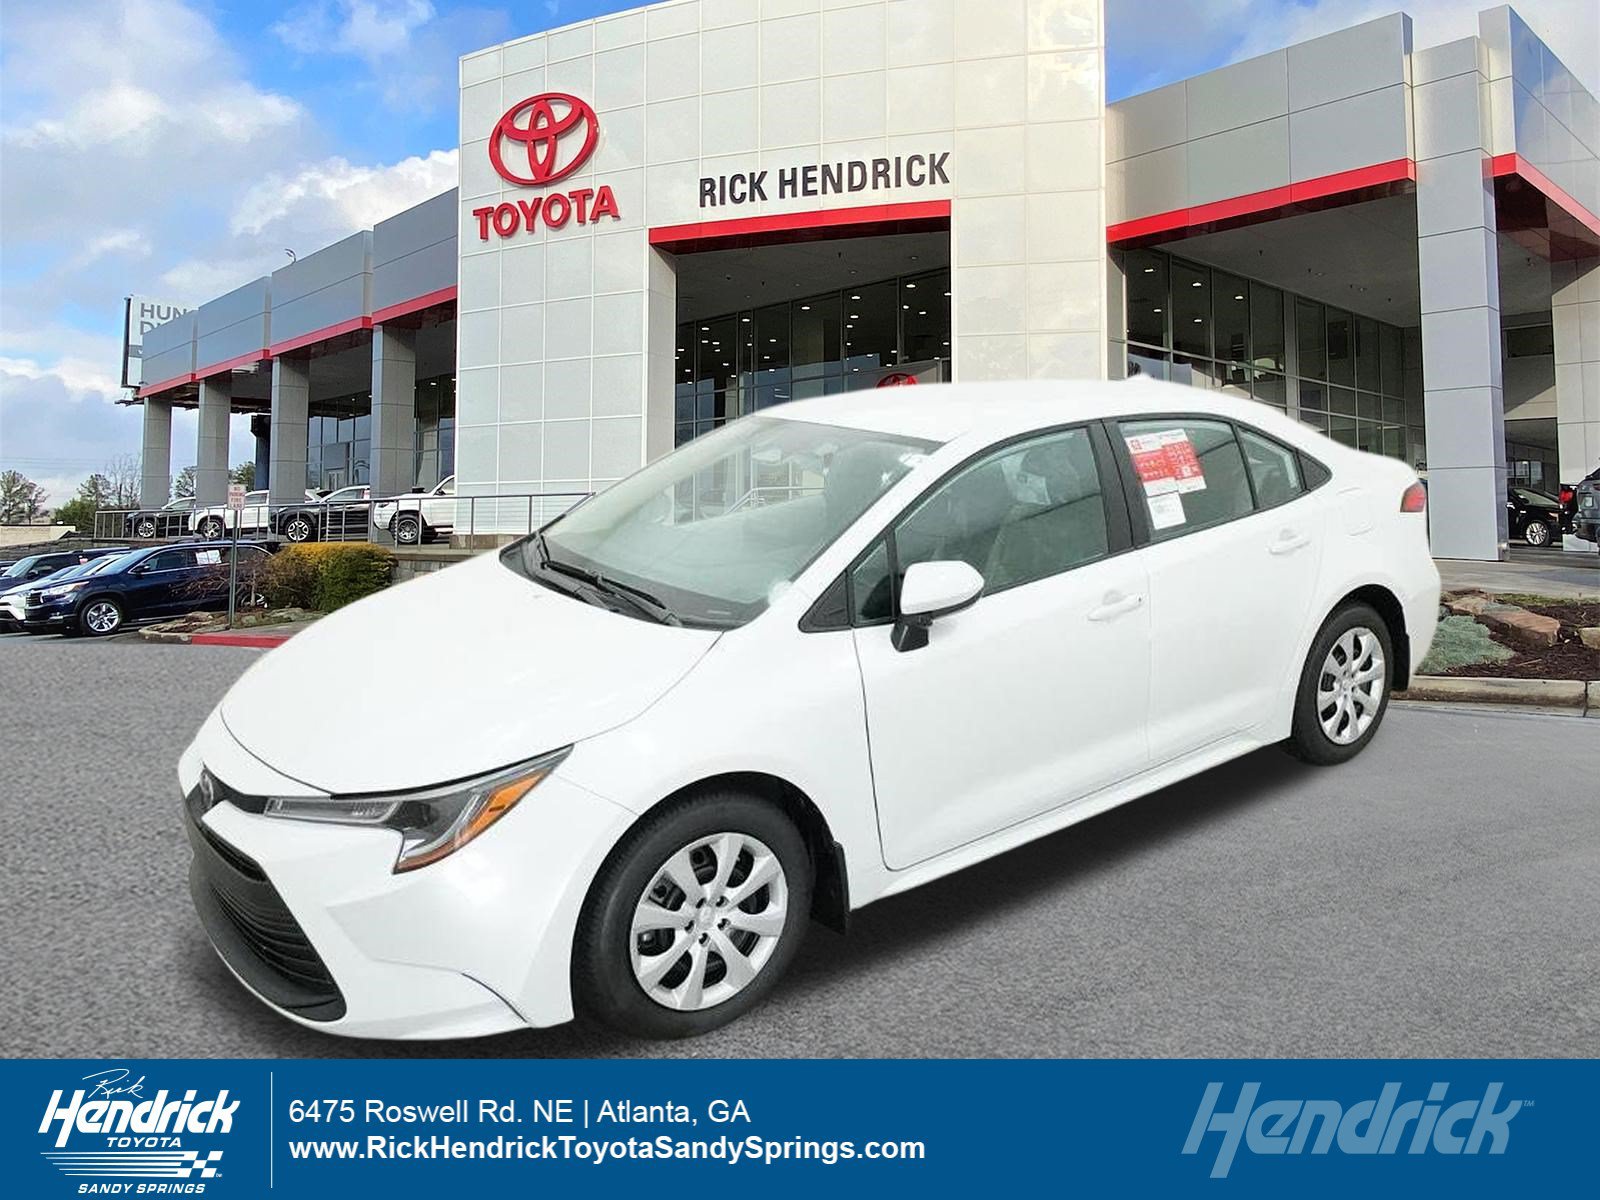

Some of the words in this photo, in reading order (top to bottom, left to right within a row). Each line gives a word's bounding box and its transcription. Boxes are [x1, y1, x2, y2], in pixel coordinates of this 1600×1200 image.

[699, 170, 768, 208] RICK
[778, 152, 951, 200] HENDRICK
[472, 185, 620, 240] TOYOTA
